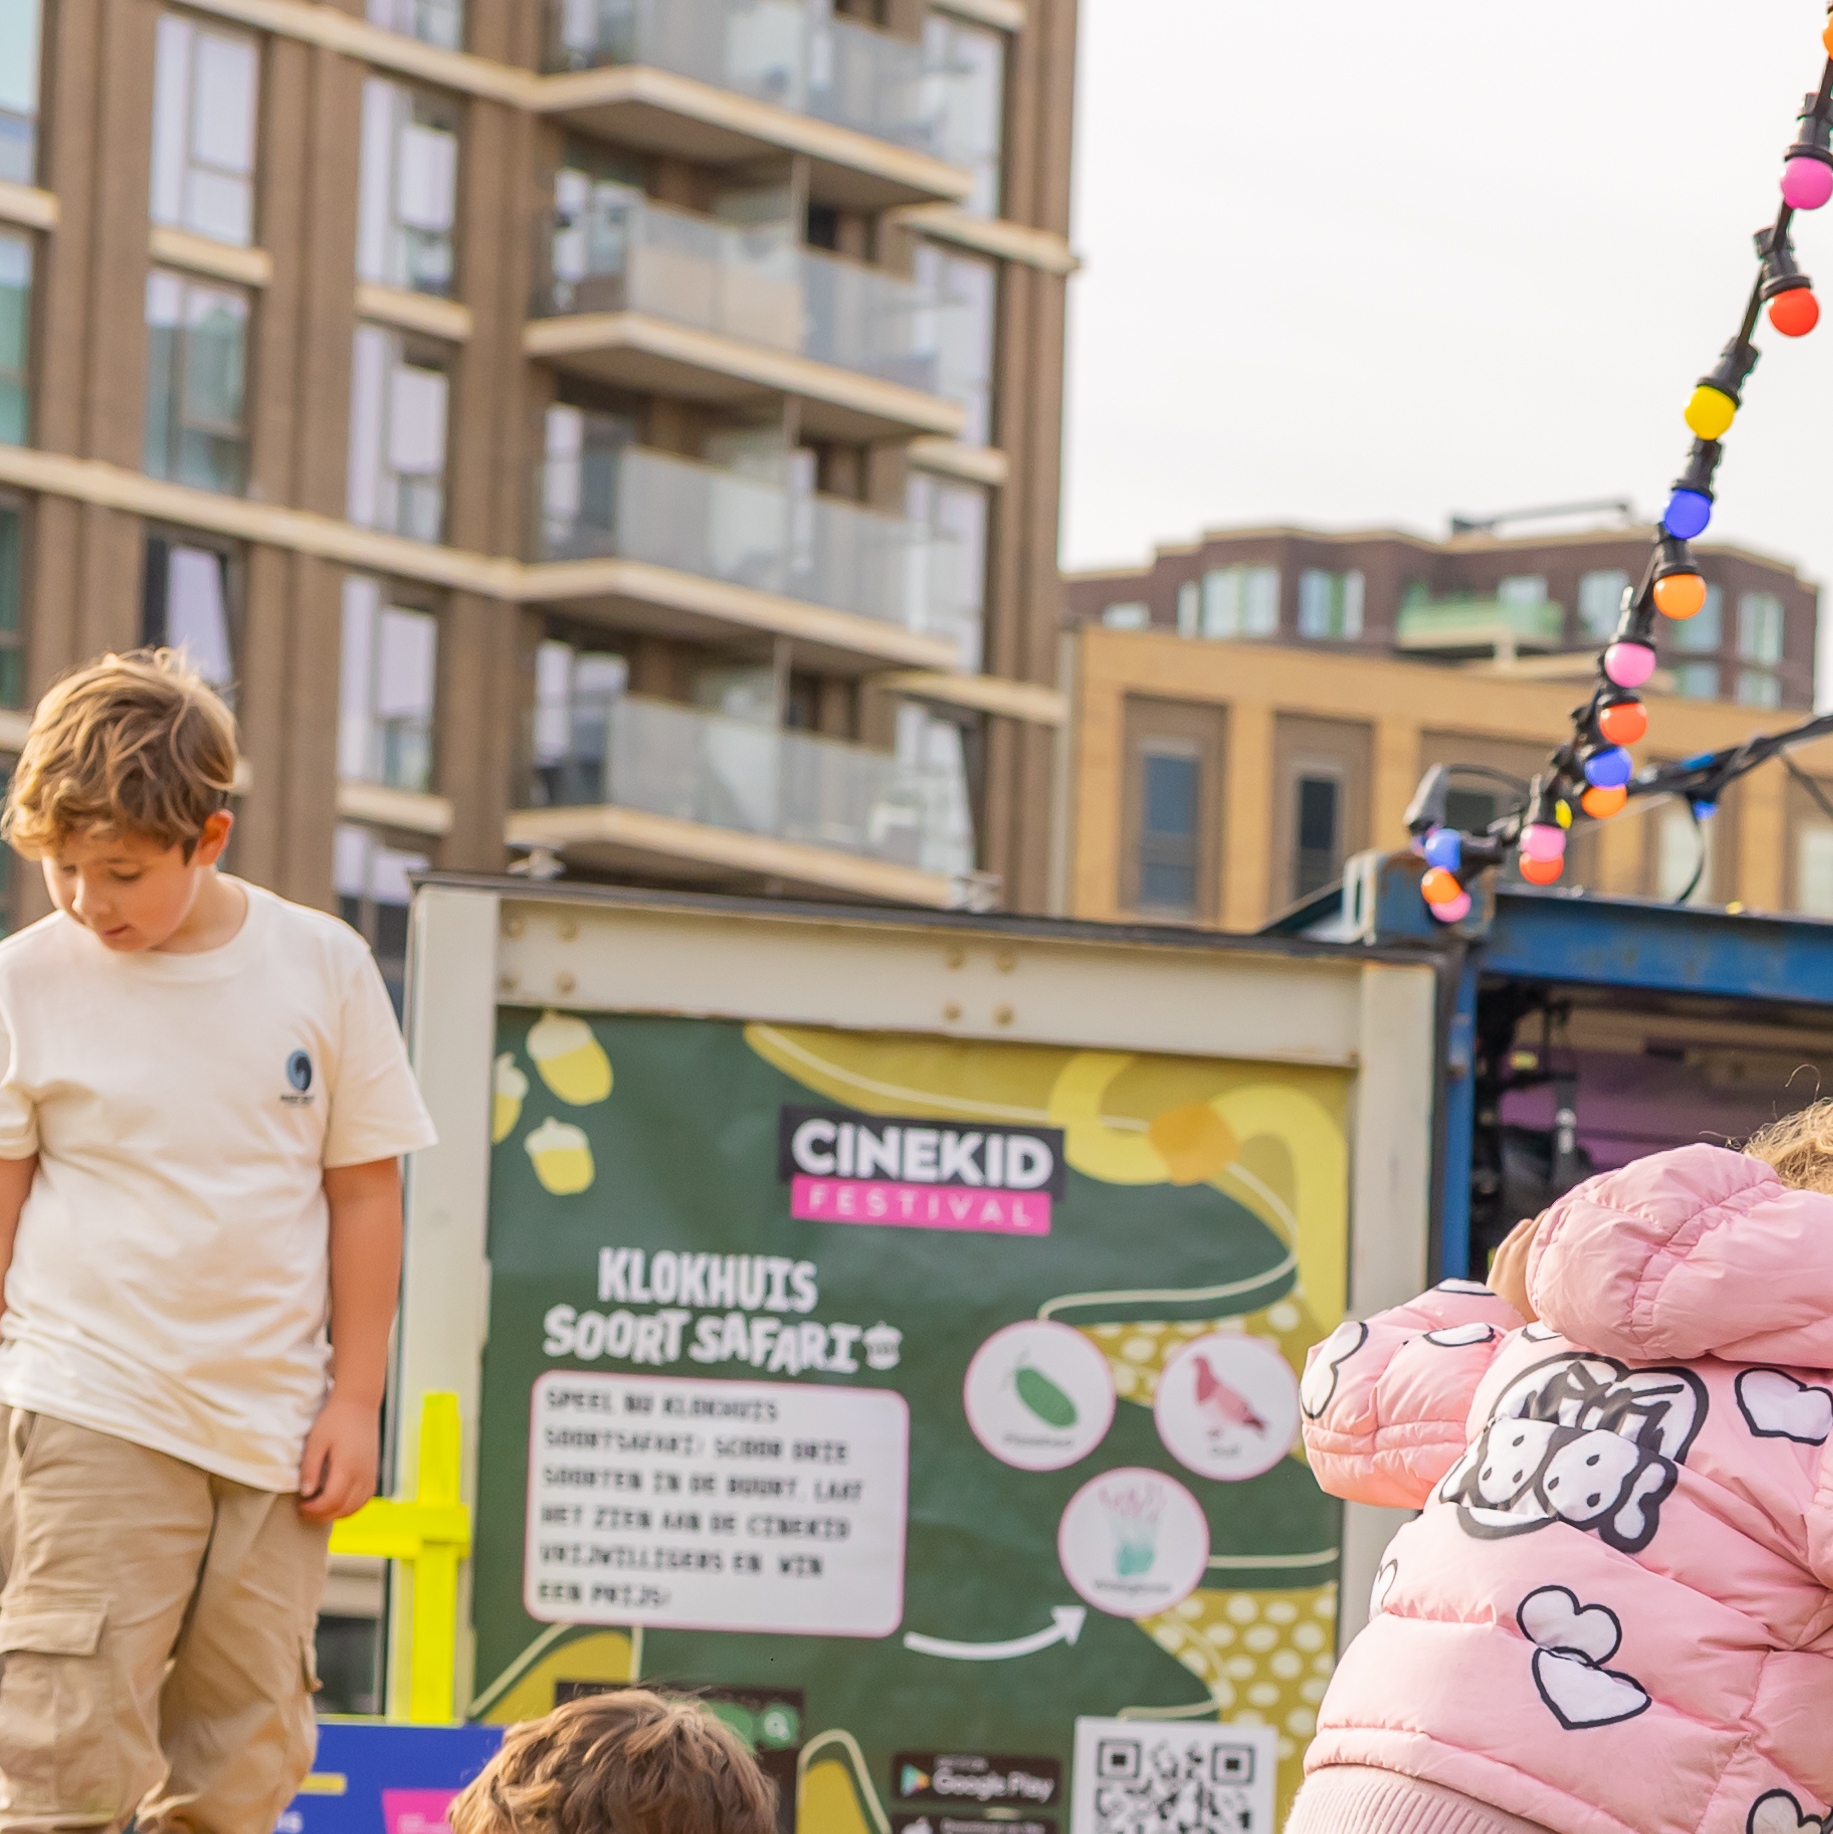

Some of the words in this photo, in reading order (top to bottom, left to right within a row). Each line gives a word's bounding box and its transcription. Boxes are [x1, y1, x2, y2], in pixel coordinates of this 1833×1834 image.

[791, 1118, 1054, 1190] CINEKID
[808, 1183, 1033, 1228] FESTIVAL
[598, 1246, 818, 1313] KLOKHUIS
[543, 1304, 692, 1365] SOORT
[688, 1311, 862, 1376] SAFARI
